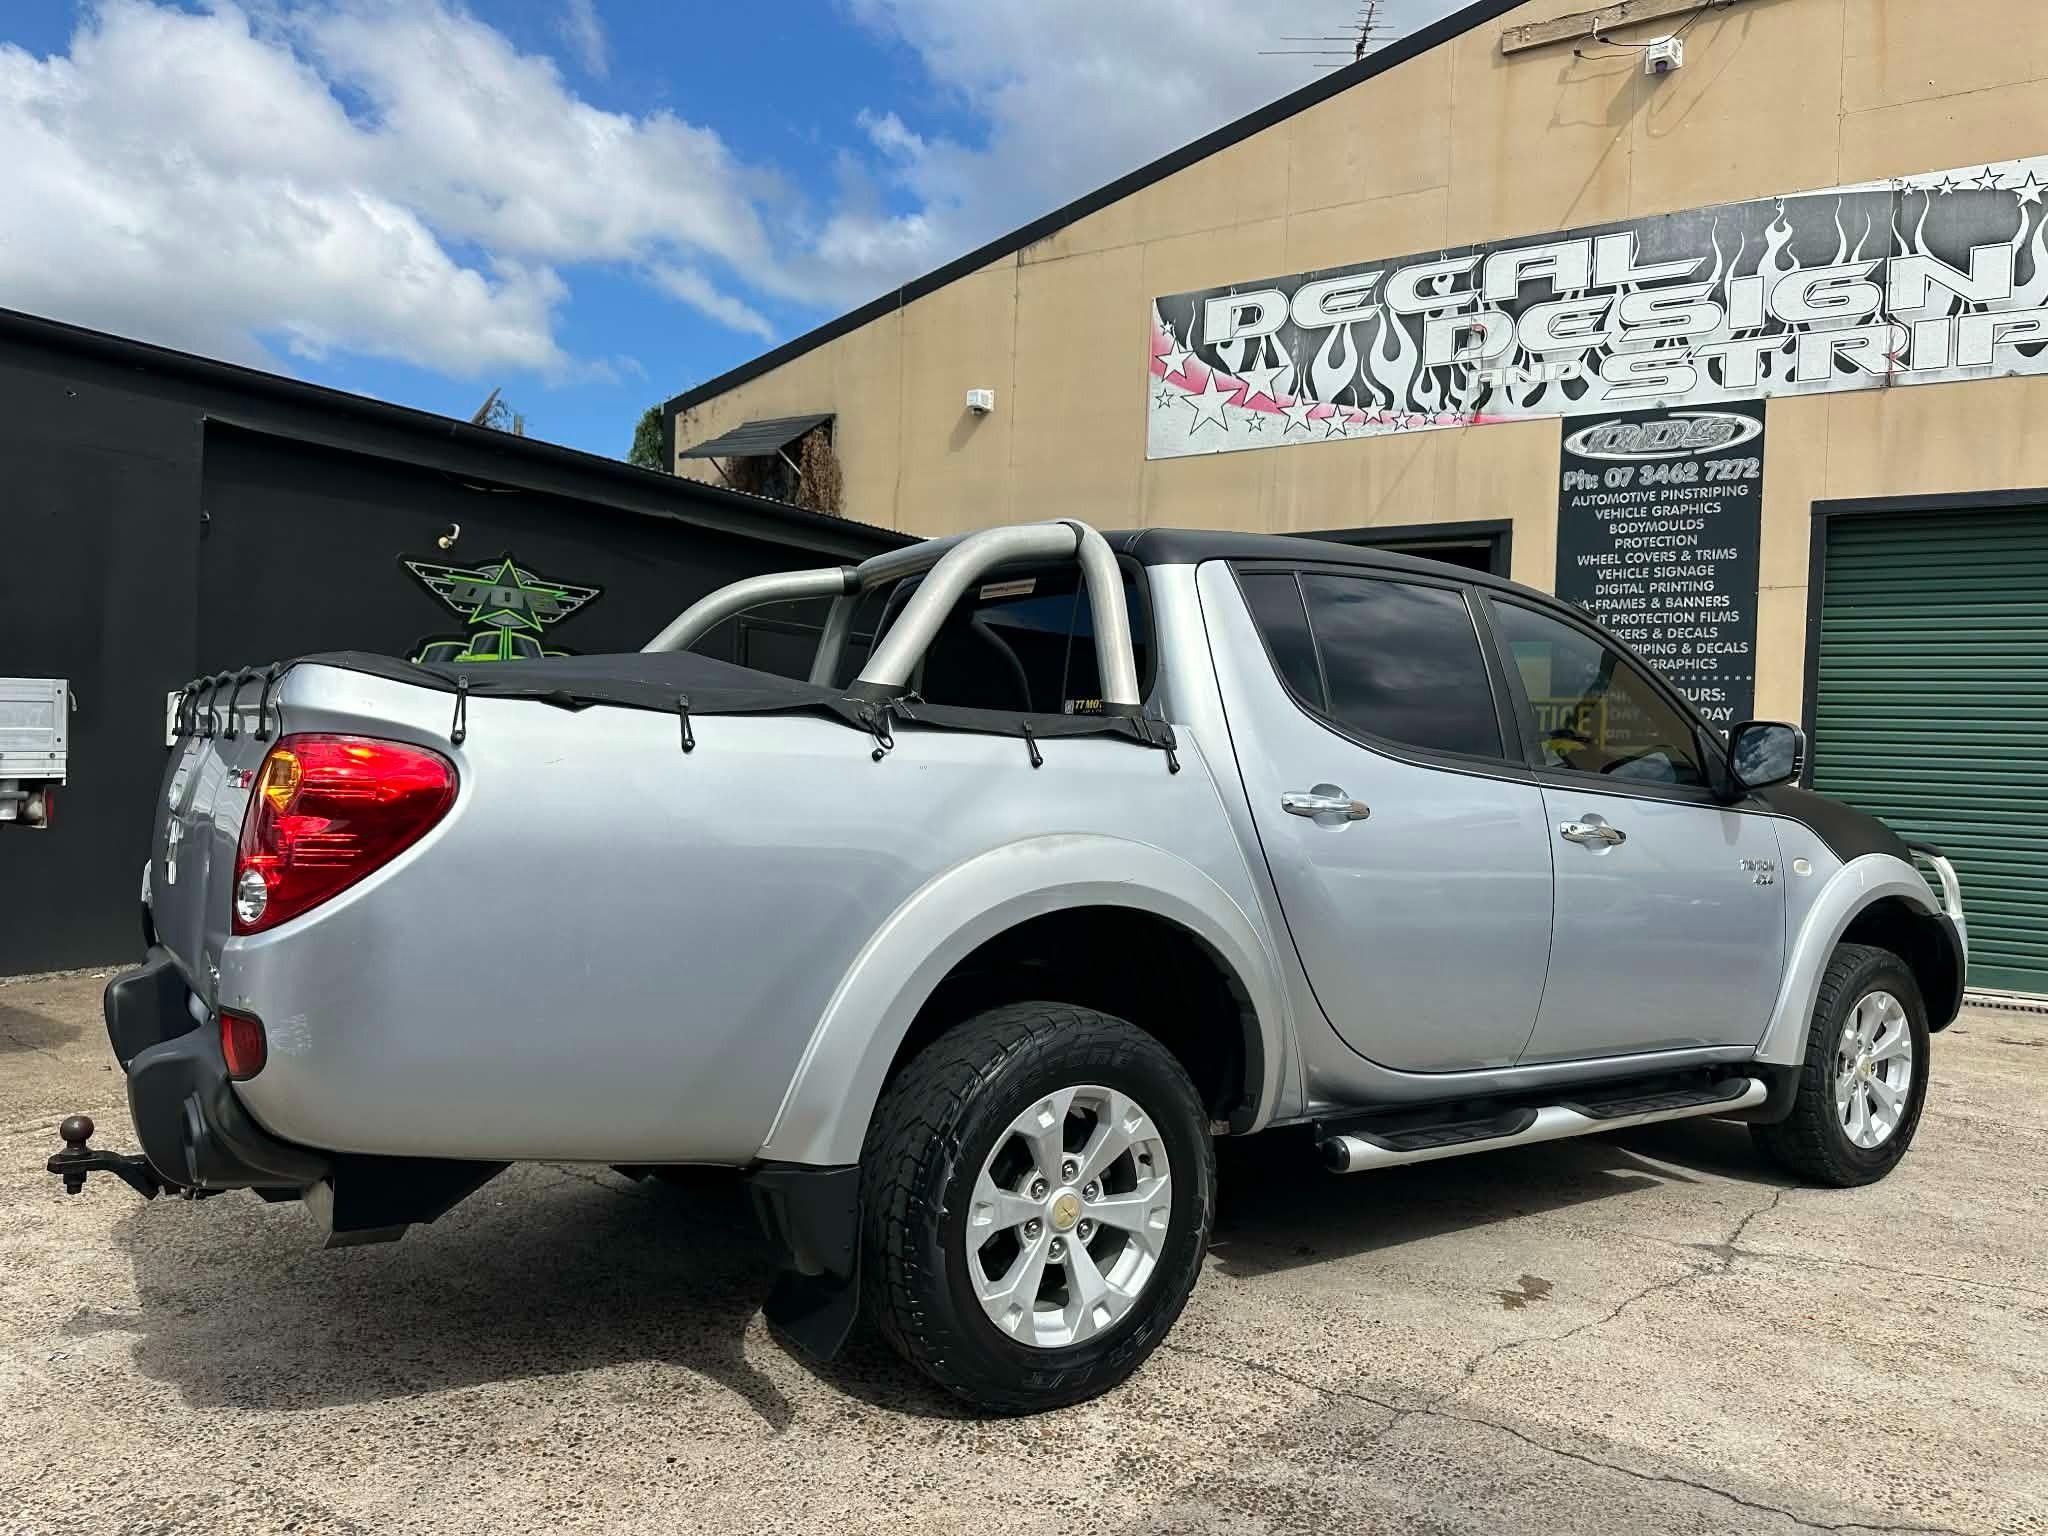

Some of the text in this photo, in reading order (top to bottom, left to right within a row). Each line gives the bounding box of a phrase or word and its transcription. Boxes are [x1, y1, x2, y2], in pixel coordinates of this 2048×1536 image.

[1203, 231, 1706, 345] DECAL
[1423, 242, 2014, 367] DESIGN
[1466, 359, 1583, 391] AND
[1563, 457, 1760, 491] Ph: 07 3462 7272
[1571, 484, 1749, 507] AUTOMOTIVE PINSTRIPING
[1595, 502, 1722, 520] VEHICLE GRAPHICS
[1609, 518, 1705, 534] BODYMOULDS
[1615, 535, 1698, 549] PROTECTION
[1577, 548, 1738, 567] WHEEL COVERS & TRIMS
[1597, 564, 1715, 580] VEHICLE SIGNAGE
[1595, 580, 1715, 595] DIGITAL PRINTING
[1651, 597, 1661, 609] &
[1665, 595, 1730, 608] BANNERS
[1611, 611, 1695, 625] PROTECTION
[1700, 610, 1740, 623] FILMS
[1652, 628, 1663, 639] &
[1667, 626, 1718, 640] DECALS
[1681, 642, 1692, 654] &
[1696, 641, 1749, 655] DECALS
[1648, 658, 1719, 670] GRAPHICS
